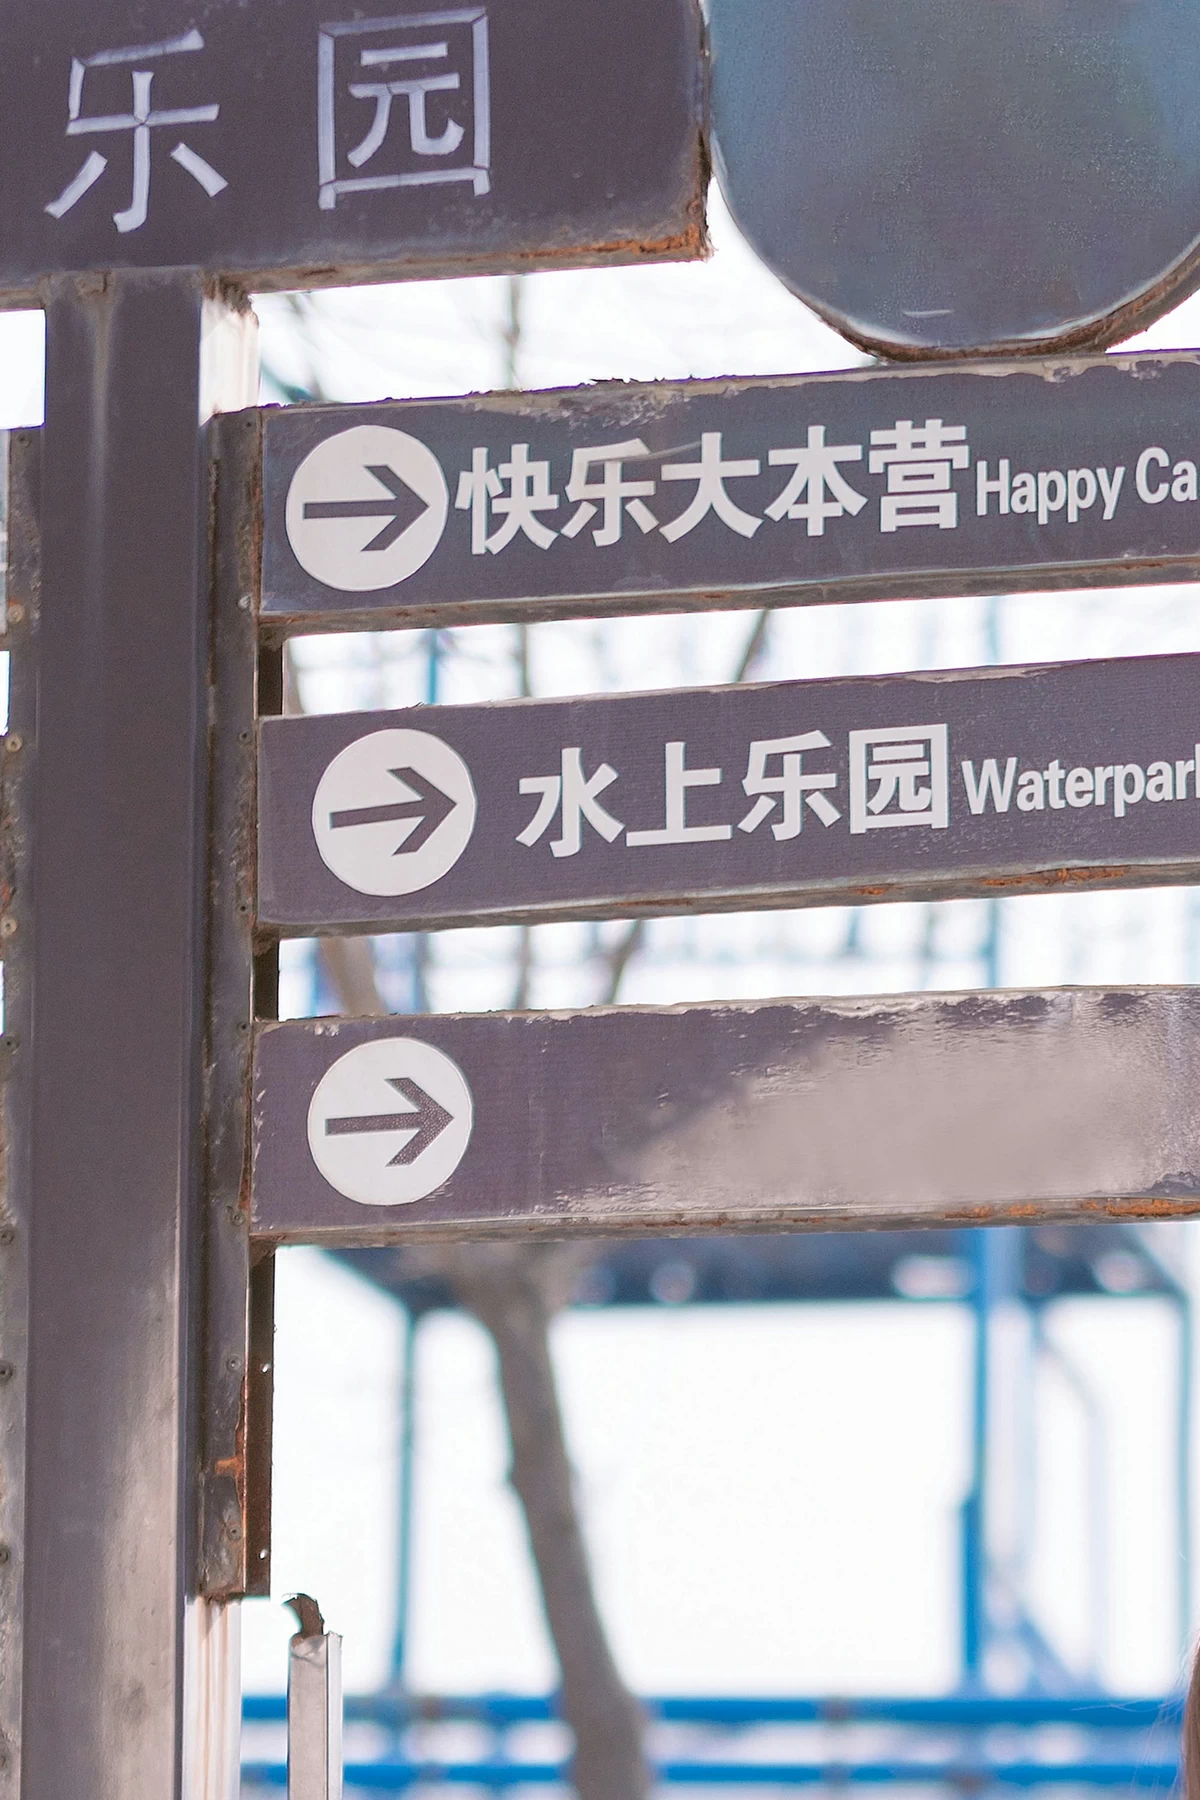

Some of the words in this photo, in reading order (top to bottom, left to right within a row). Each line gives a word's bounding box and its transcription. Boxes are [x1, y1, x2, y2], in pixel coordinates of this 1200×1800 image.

[43, 8, 491, 233] 乐园
[454, 418, 969, 555] 快乐大本营
[976, 459, 1125, 526] Happy
[515, 723, 949, 858] 水上乐园
